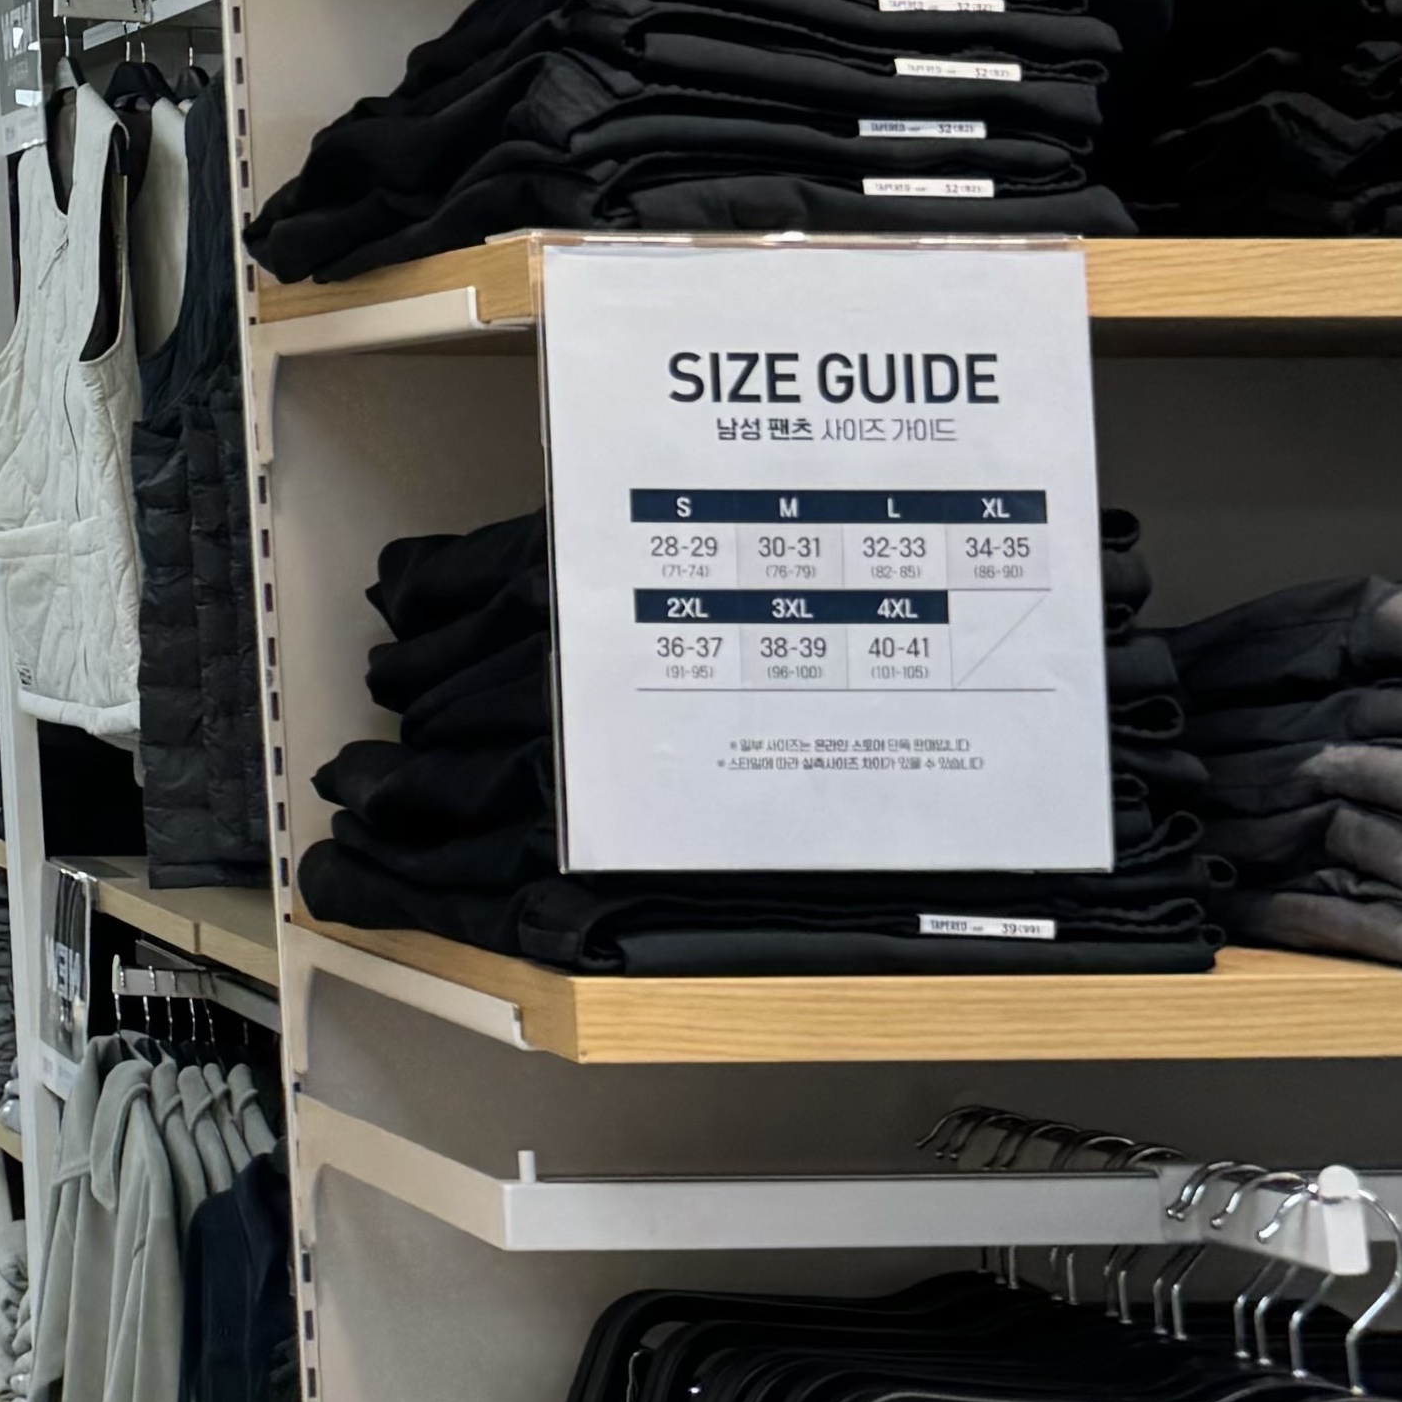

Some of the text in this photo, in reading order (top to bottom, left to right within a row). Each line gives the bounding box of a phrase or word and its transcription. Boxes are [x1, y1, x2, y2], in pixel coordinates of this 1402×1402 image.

[668, 351, 1000, 404] SIZE GUIDE
[716, 418, 959, 441] 남성 팬츠 사이즈 가이드
[676, 498, 1010, 518] S M L XL
[650, 536, 1030, 558] 28-29 30-31 32-33 34-35
[662, 564, 1023, 579] (71-74) (76-79) (82-85) (86-90)
[667, 598, 918, 619] 2XL 3XL 4XL
[657, 637, 929, 658] 36-37 38-39 40-41
[666, 665, 929, 680] (91-95) (96-100) (101-105)
